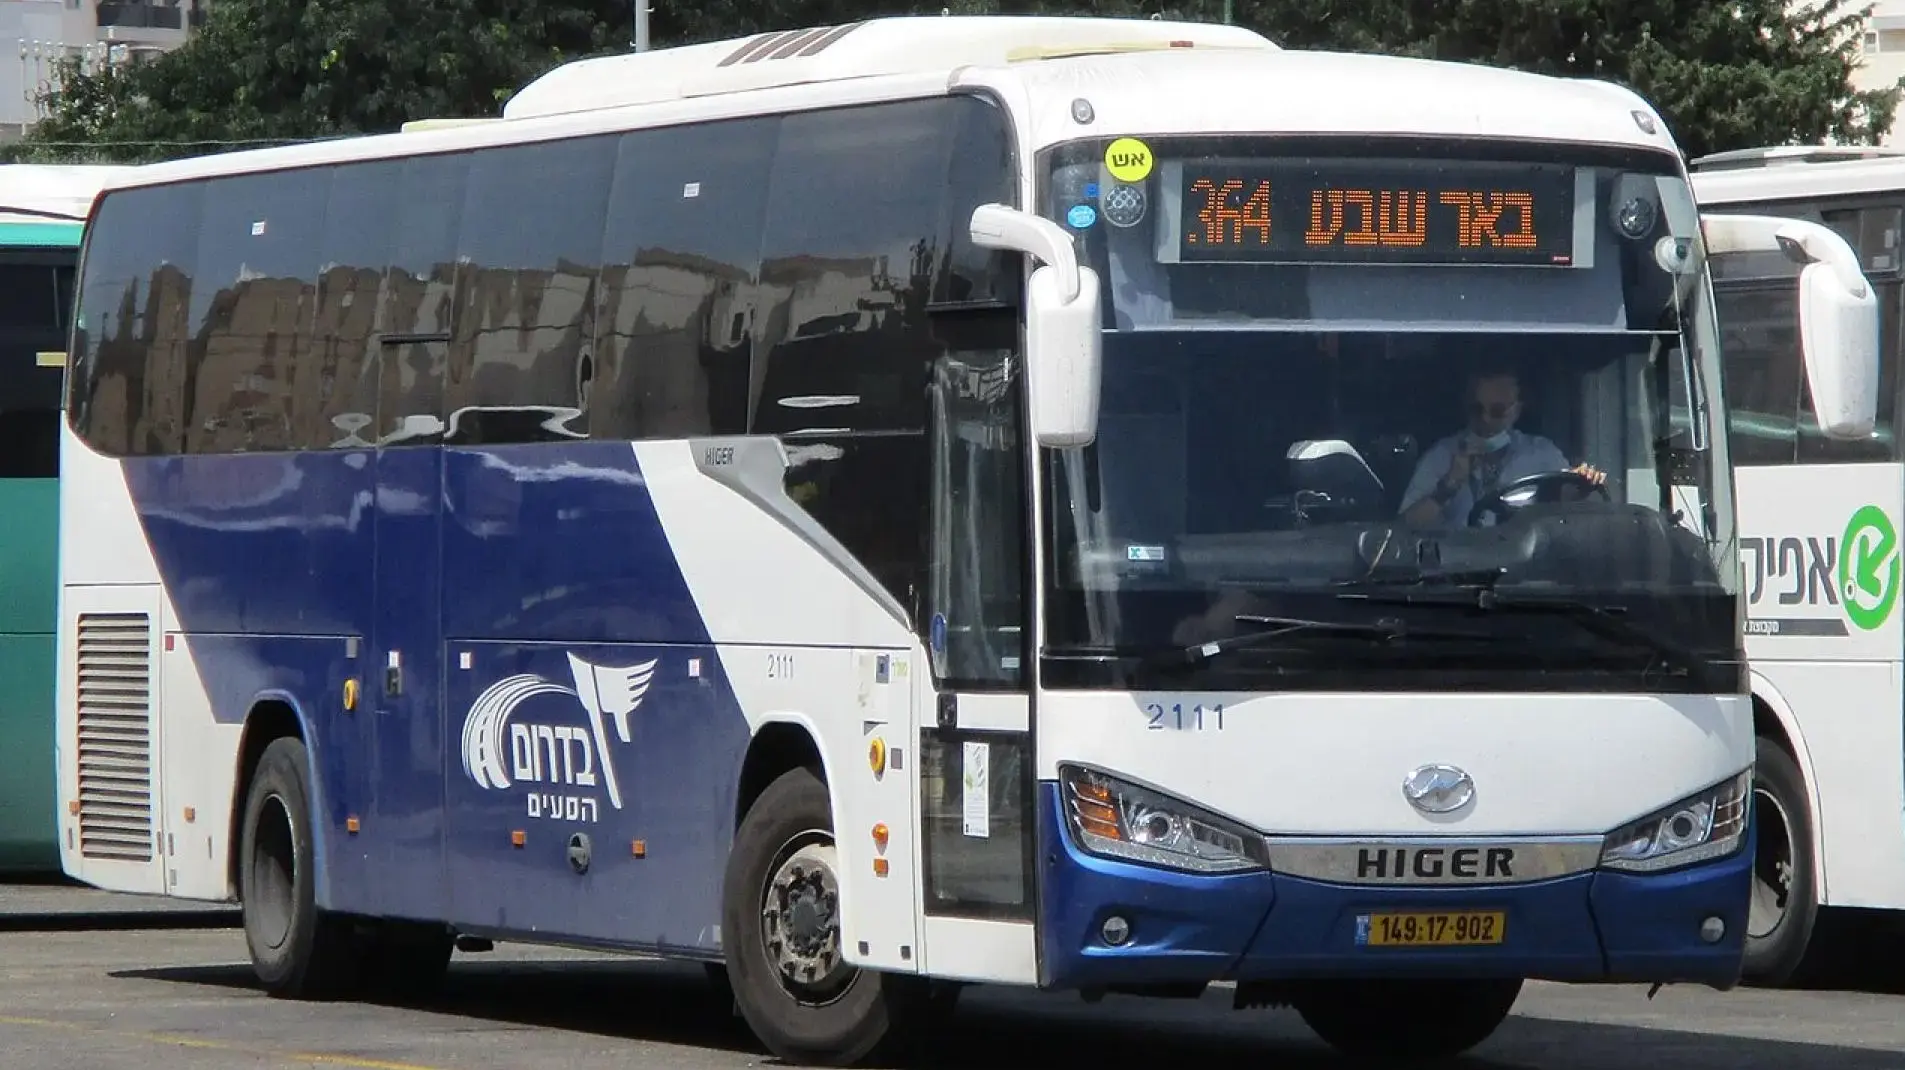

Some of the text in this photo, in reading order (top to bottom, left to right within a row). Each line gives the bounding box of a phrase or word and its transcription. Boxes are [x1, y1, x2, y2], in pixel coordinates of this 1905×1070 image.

[1112, 153, 1145, 168] אש
[1188, 180, 1271, 243] 364
[1305, 190, 1536, 248] באר שבע
[704, 447, 734, 465] HIGER
[767, 654, 794, 678] 2111
[1148, 703, 1224, 731] 2111
[510, 723, 596, 786] בדרום
[527, 793, 599, 823] הסעים
[1357, 847, 1515, 878] HIGER
